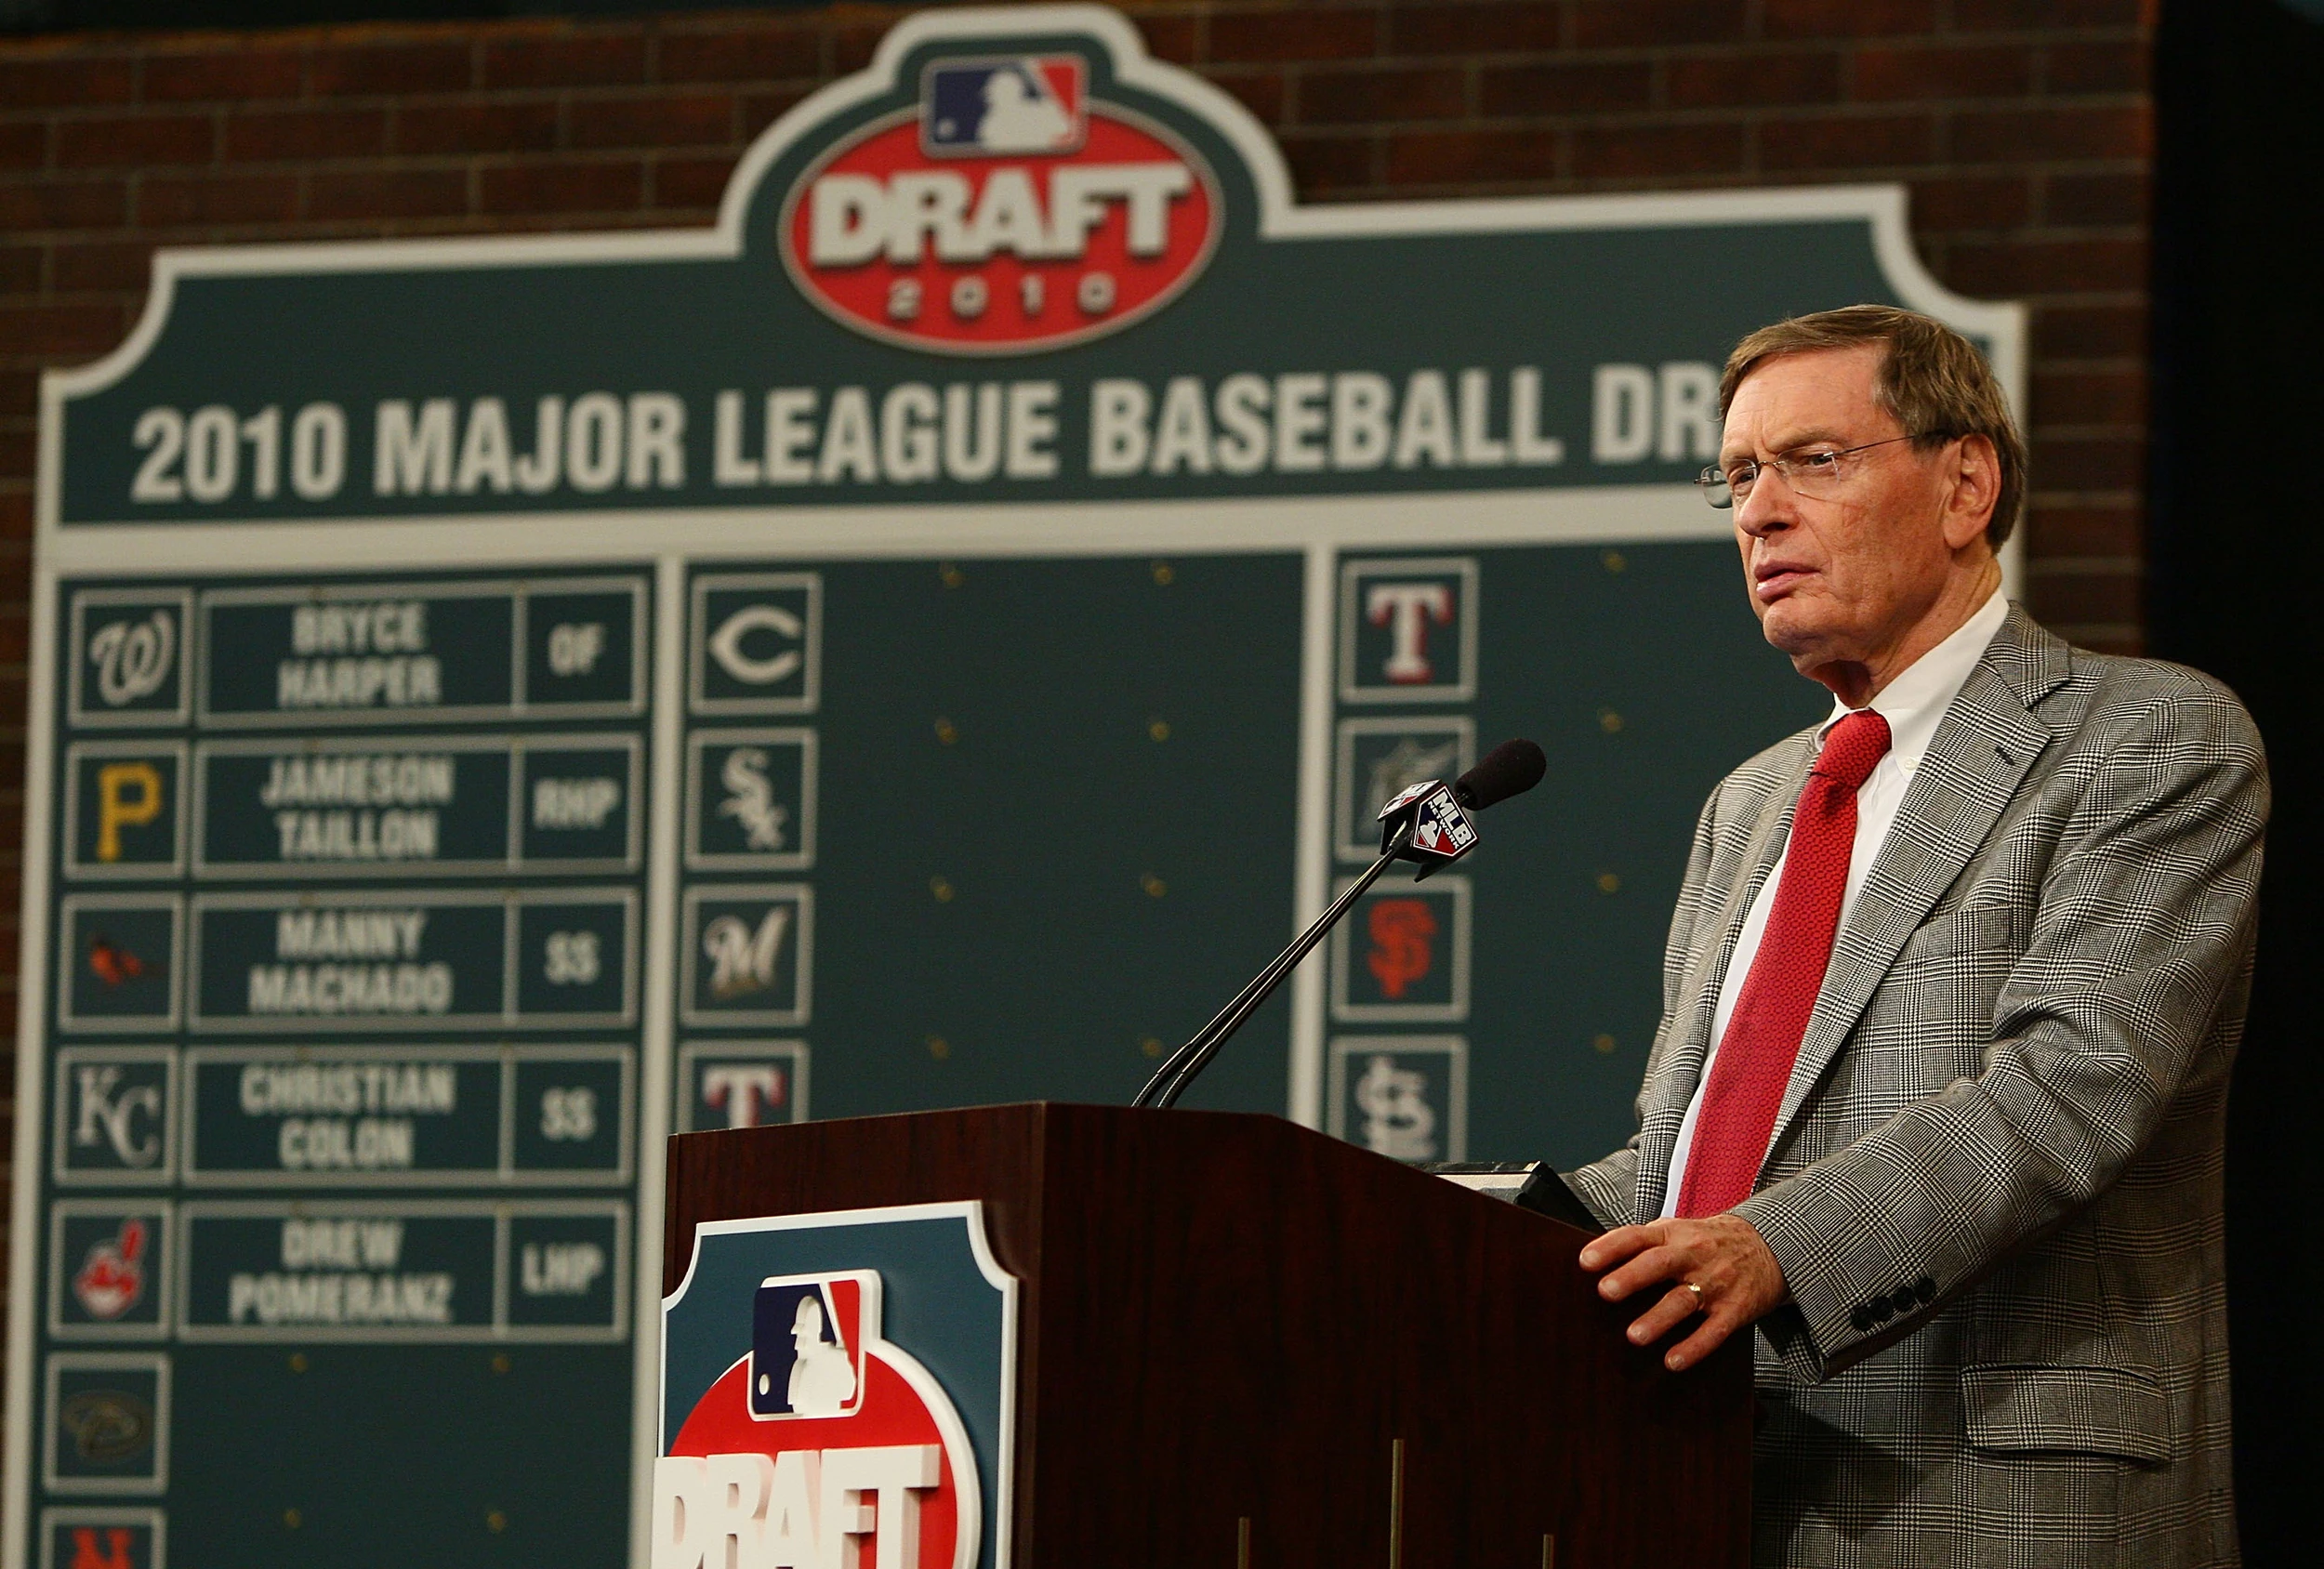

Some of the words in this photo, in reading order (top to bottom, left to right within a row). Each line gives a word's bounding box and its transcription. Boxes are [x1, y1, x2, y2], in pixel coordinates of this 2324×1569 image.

[809, 160, 1193, 267] DRAFT
[887, 272, 1118, 322] 2010
[130, 402, 348, 504] 2010
[374, 390, 686, 496] MAJOR
[713, 379, 1061, 488] LEAGUE
[1089, 365, 1565, 477] BASEBALL
[291, 604, 428, 653] BRYCE
[548, 624, 606, 676] OF
[1367, 583, 1453, 684] T
[278, 658, 443, 707] HARPER
[260, 758, 454, 807] JAMESON
[534, 778, 619, 828] RHP
[98, 764, 162, 864] P
[275, 811, 440, 860] TAILLON
[1427, 800, 1459, 850] NETWORK
[1432, 790, 1472, 846] MLB
[276, 912, 428, 960] MANNY
[544, 932, 601, 985] SS
[248, 964, 452, 1014] MACHADO
[240, 1064, 455, 1114] CHRISTIAN
[540, 1088, 596, 1141] SS
[279, 1118, 415, 1168] COLON
[282, 1220, 403, 1268] DREW
[522, 1244, 603, 1295] LHP
[229, 1272, 454, 1323] POMERANZ
[652, 1444, 941, 1569] DRAFT
